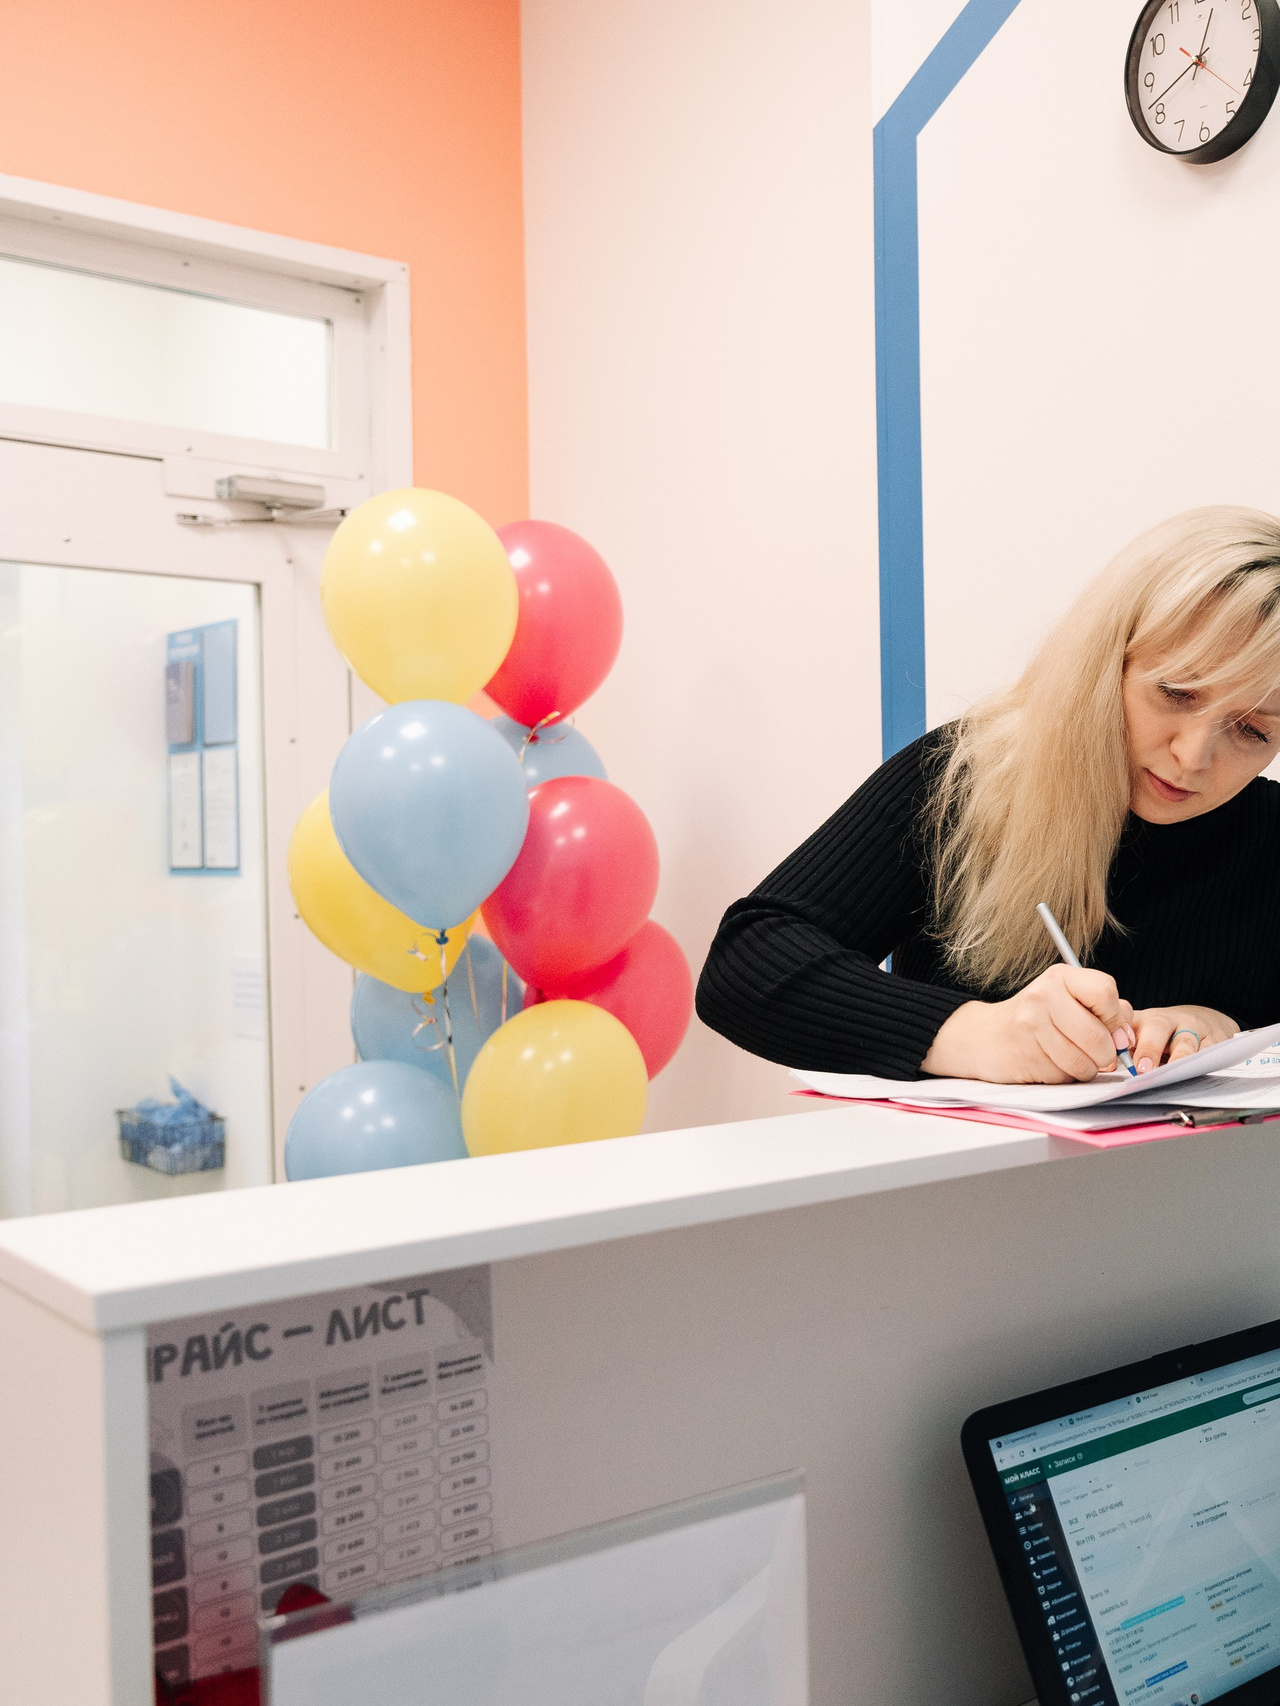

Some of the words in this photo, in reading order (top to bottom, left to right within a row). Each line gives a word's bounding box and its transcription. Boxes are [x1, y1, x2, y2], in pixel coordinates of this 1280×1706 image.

[1168, 1, 1180, 24] 11
[1150, 33, 1165, 57] 10
[1144, 72, 1155, 93] 9
[1243, 68, 1253, 86] 4
[1155, 102, 1166, 124] 8
[1174, 119, 1185, 142] 7
[1199, 121, 1210, 142] 6
[148, 1321, 272, 1382] РАЙС
[325, 1287, 430, 1346] ЛИСТ
[1053, 1455, 1076, 1468] Записи
[1003, 1473, 1019, 1484] МОЙ
[1018, 1466, 1041, 1479] КЛАСС
[1068, 1517, 1079, 1526] ВСЕ
